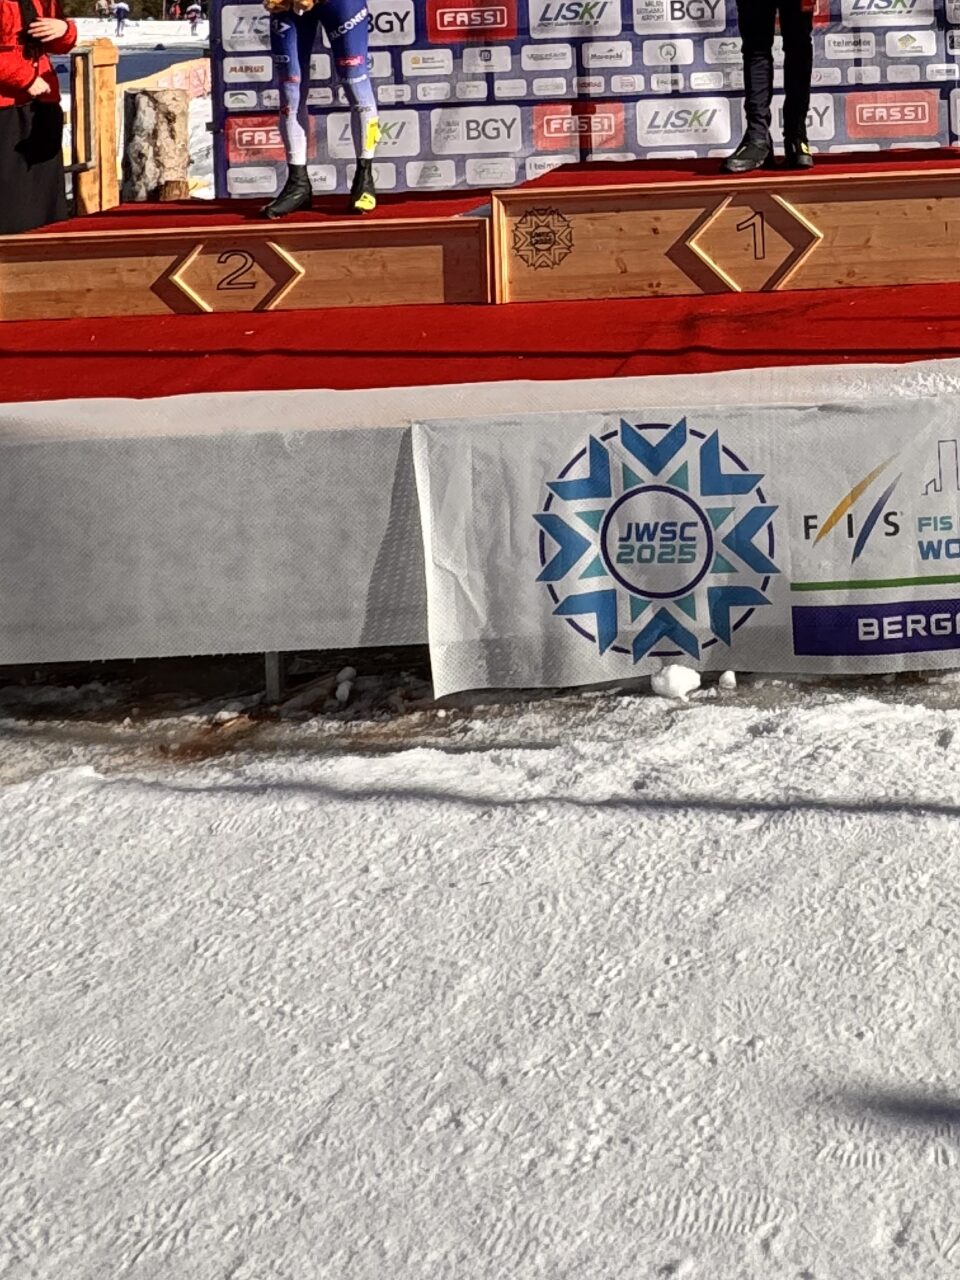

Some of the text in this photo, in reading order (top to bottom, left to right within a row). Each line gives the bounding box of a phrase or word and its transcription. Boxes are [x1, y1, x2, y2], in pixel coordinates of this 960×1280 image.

[443, 11, 501, 26] FASSI
[539, 1, 608, 21] LISKI
[231, 16, 270, 35] LIS
[647, 109, 717, 130] LISKI
[862, 106, 922, 121] FASSI
[338, 121, 406, 141] LKI
[465, 117, 517, 141] BGY
[550, 117, 610, 133] FASSI
[242, 131, 281, 144] FAS
[735, 204, 768, 261] 1
[216, 249, 257, 291] 2
[619, 522, 699, 543] JWSC
[803, 510, 901, 539] FIS
[917, 514, 956, 533] FIS
[616, 543, 697, 564] 2025
